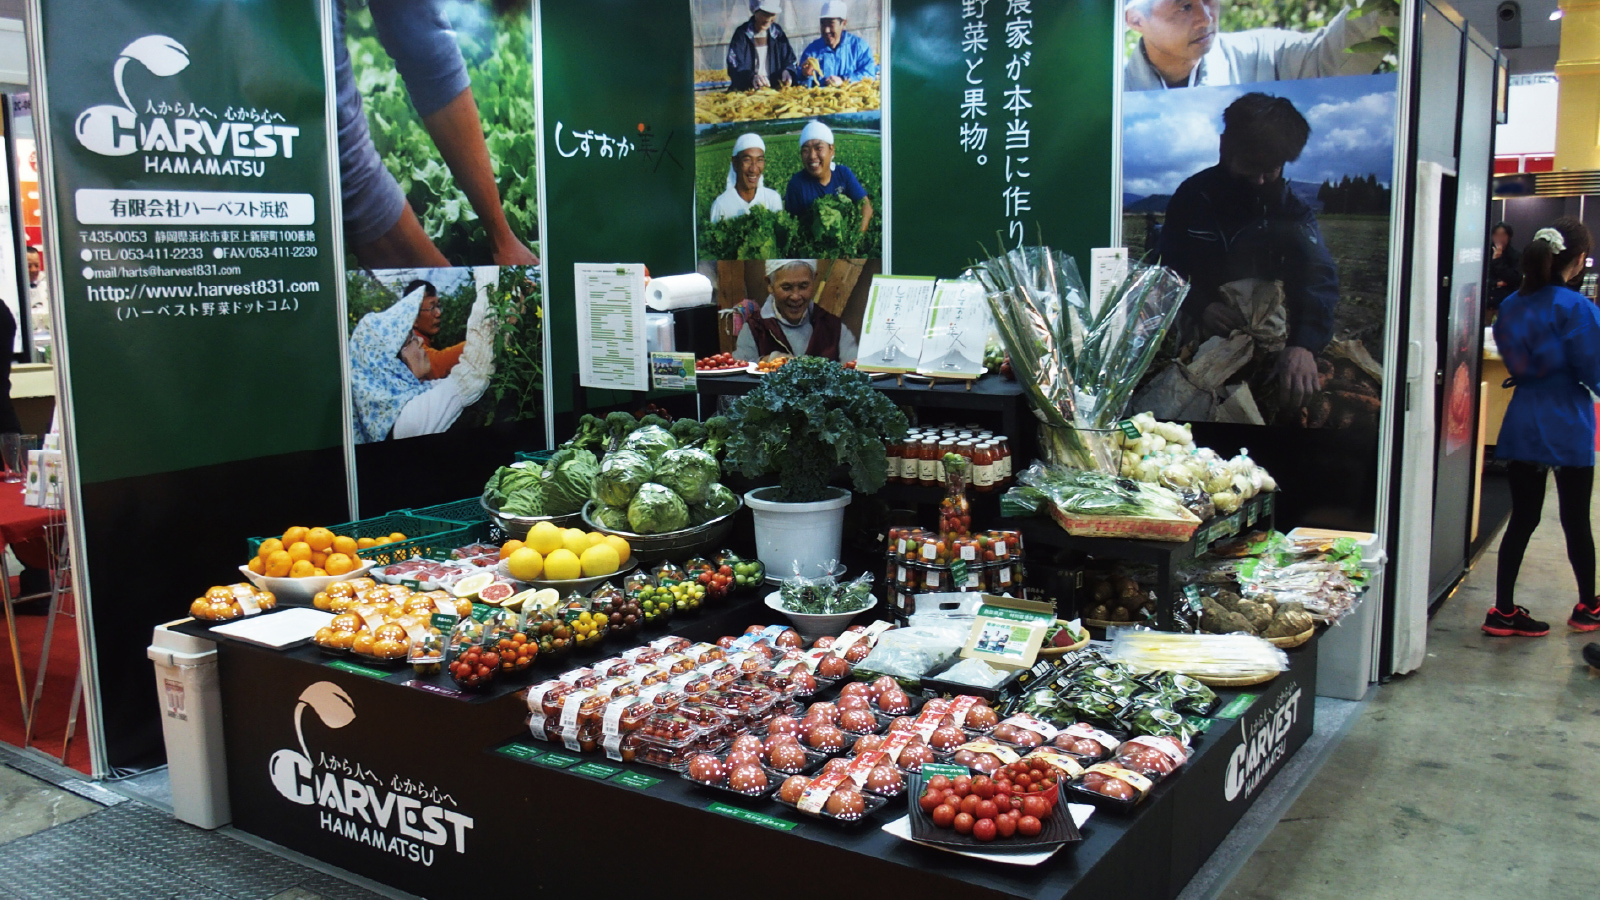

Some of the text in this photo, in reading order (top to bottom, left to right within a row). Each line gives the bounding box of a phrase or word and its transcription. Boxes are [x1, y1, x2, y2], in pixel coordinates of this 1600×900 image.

[145, 157, 265, 177] HAMAMATSU
[110, 198, 289, 219] 有限会社ハーベスト浜松
[94, 264, 241, 279] mail/harts@harvest831.com
[87, 279, 320, 302] http://www.harvest831.com
[320, 810, 435, 867] HAMAMATSU
